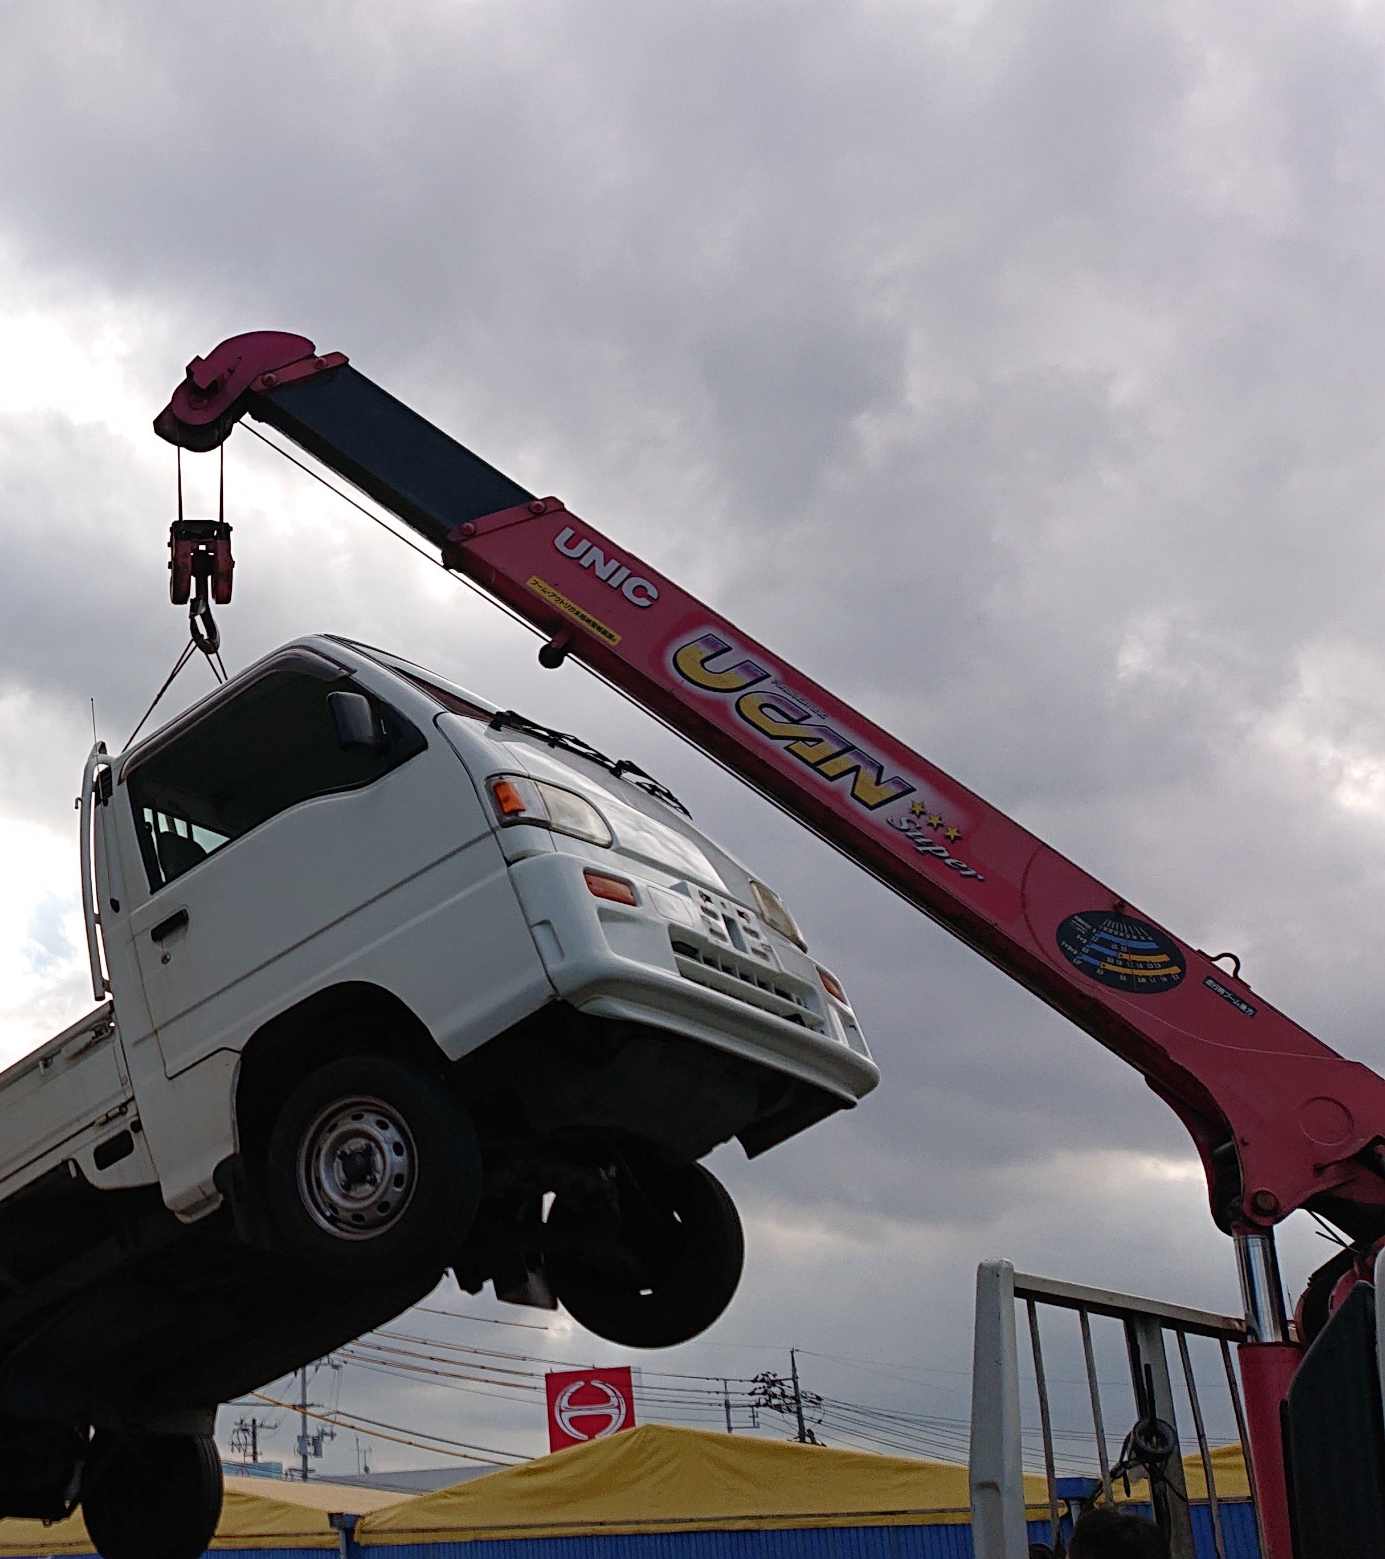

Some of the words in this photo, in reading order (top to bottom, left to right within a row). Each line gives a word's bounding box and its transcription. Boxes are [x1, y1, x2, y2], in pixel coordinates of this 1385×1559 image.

[553, 526, 659, 608] UNIC
[673, 633, 917, 811] UCAN
[886, 814, 985, 882] Super
